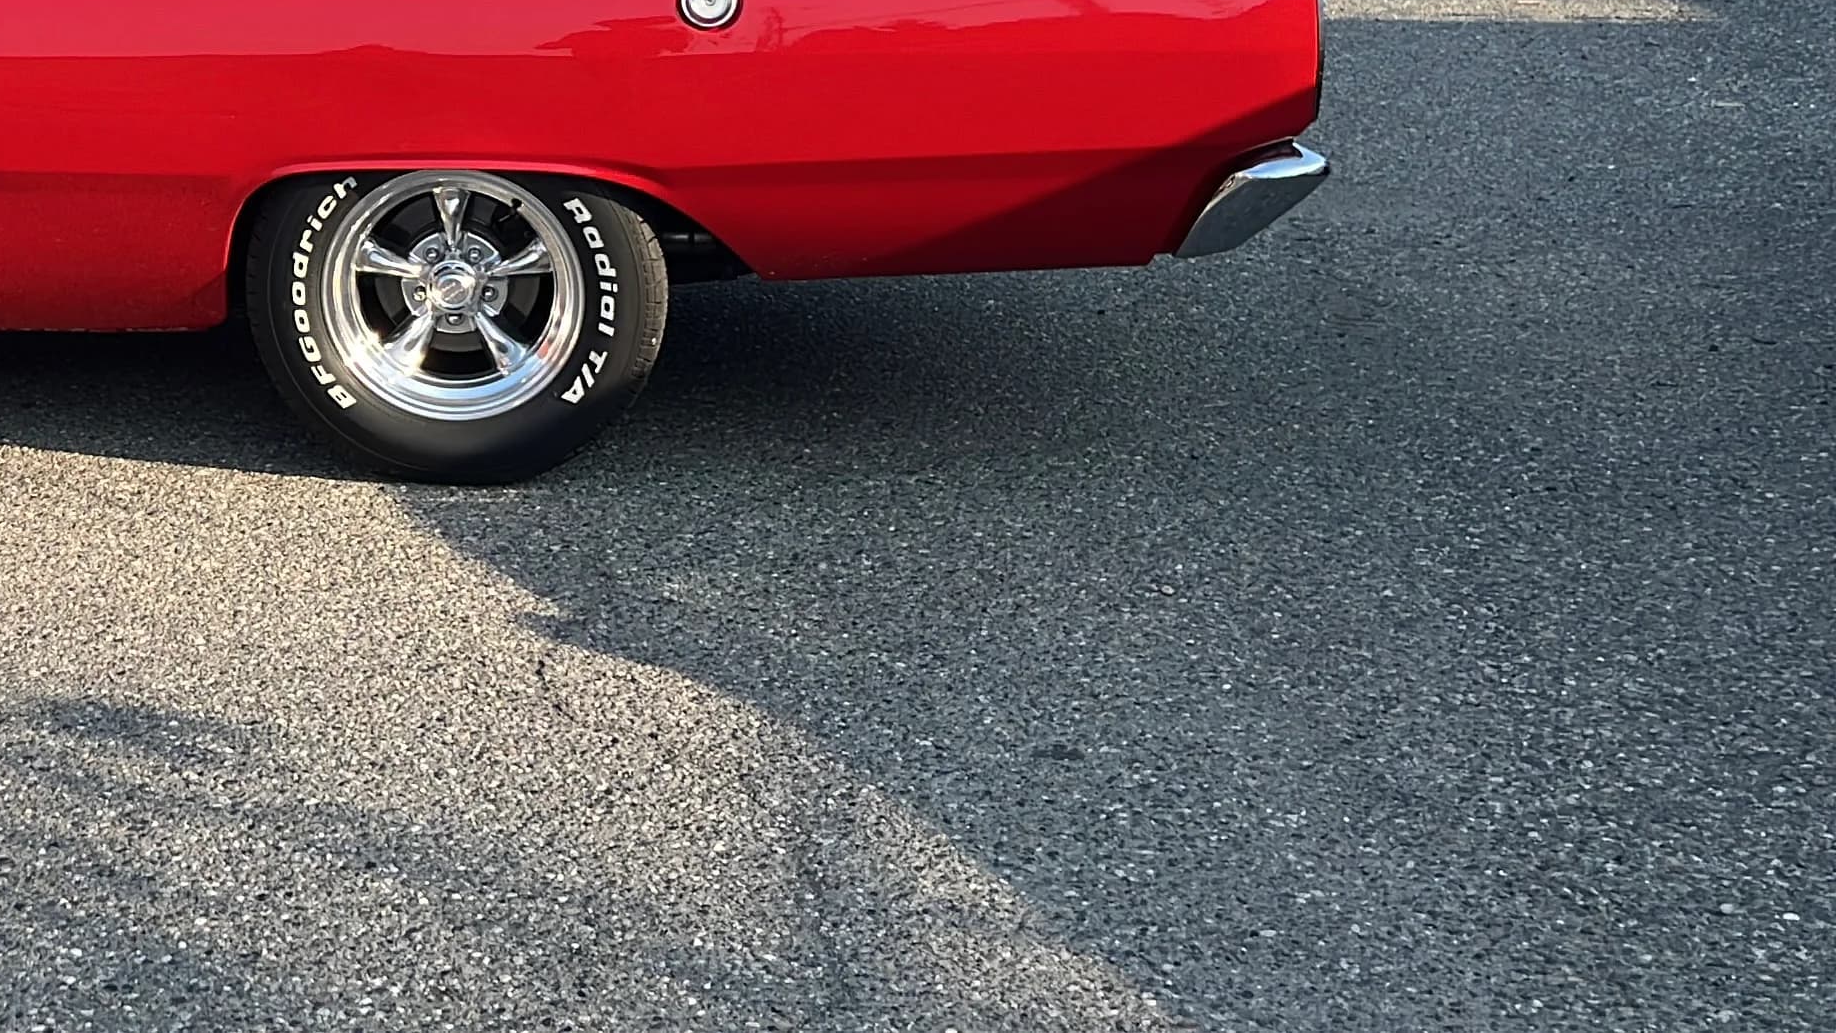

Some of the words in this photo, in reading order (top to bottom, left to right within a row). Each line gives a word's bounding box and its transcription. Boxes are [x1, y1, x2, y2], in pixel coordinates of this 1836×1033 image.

[291, 175, 359, 411] BFGoodrich
[562, 197, 619, 337] Radial
[560, 349, 609, 405] T/A
